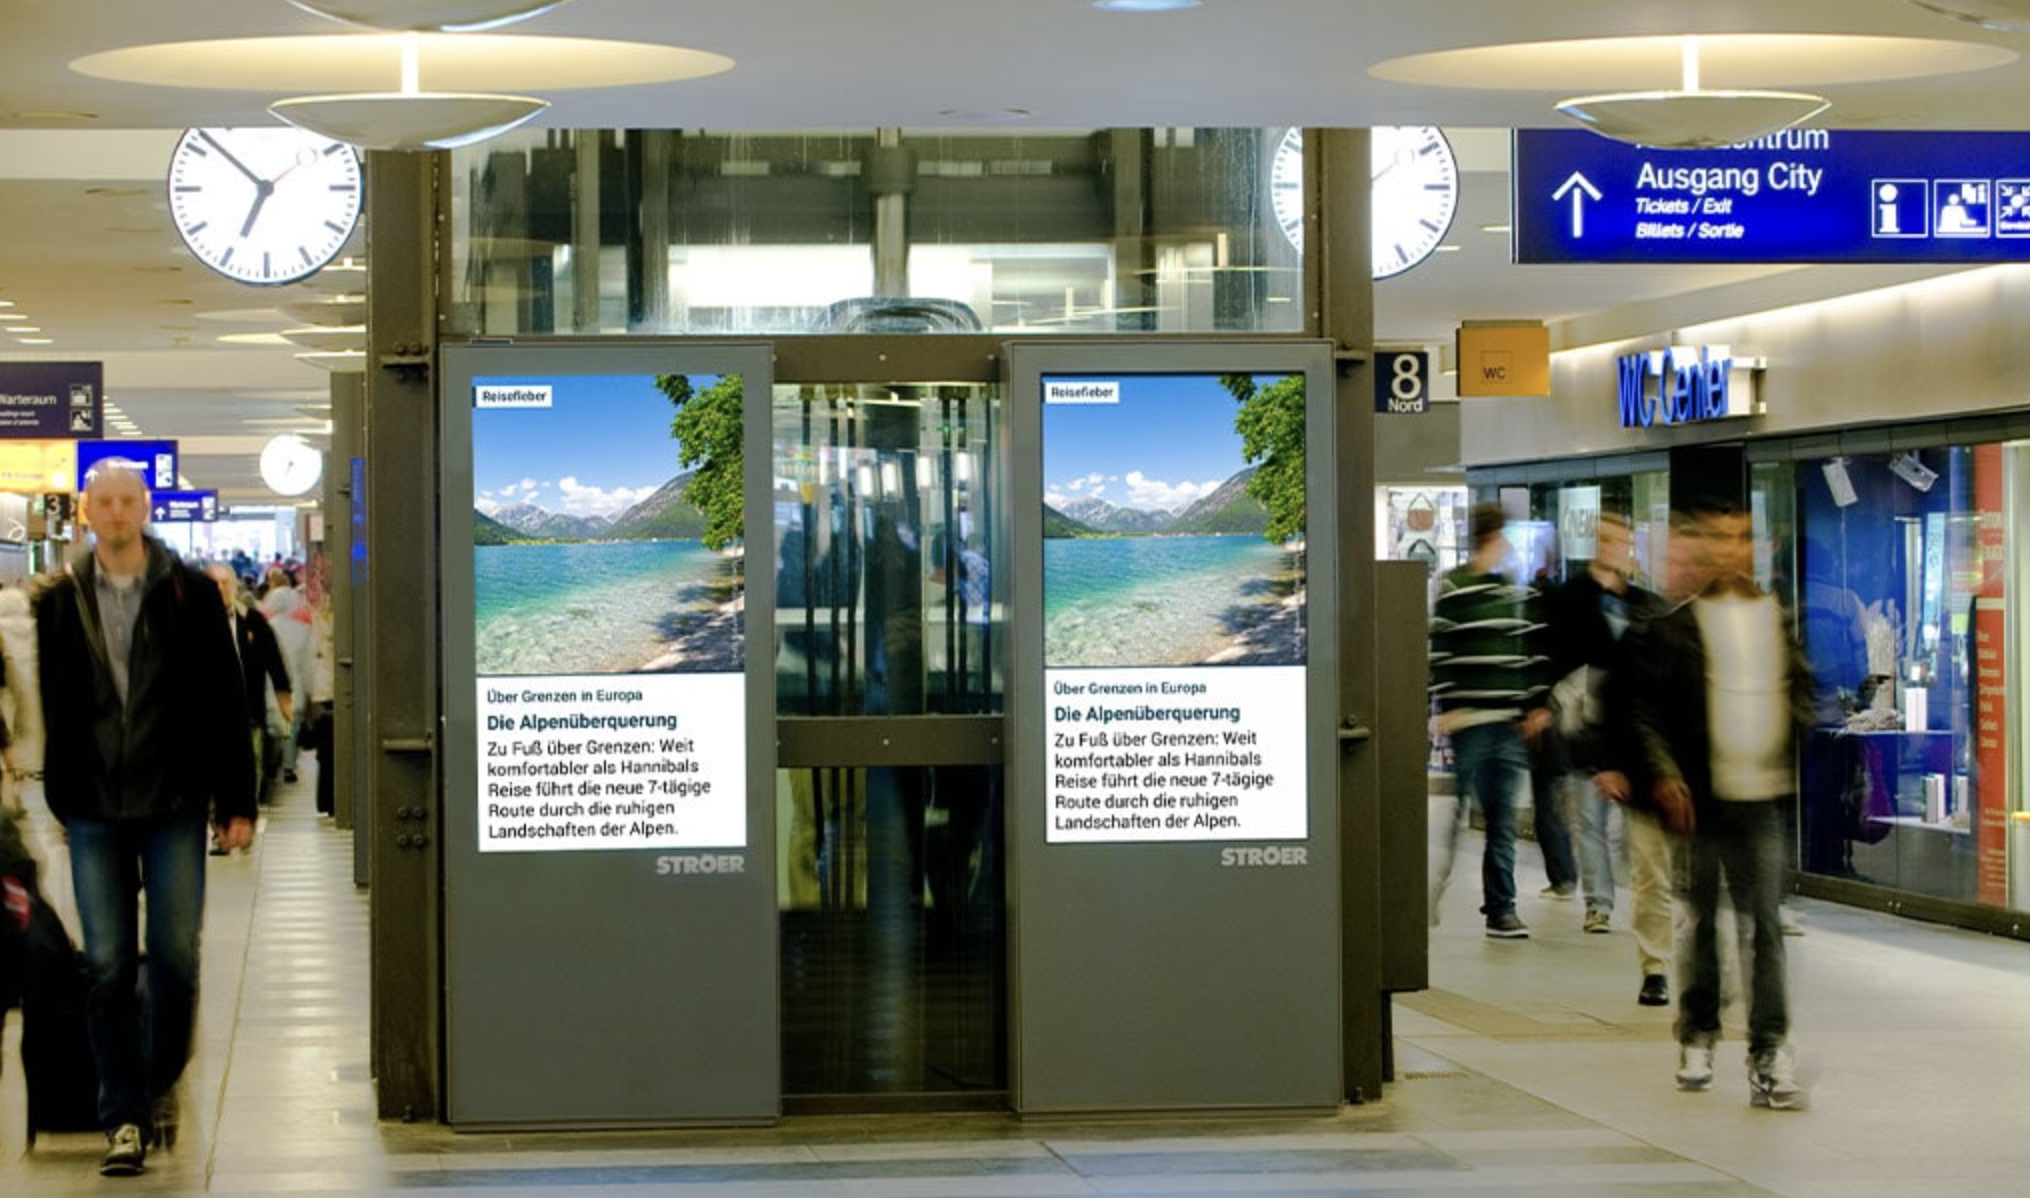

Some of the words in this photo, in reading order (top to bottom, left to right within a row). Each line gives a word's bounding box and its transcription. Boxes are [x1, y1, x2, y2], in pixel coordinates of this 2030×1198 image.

[1636, 162, 1759, 196] Ausgang
[1768, 162, 1823, 196] City
[1635, 198, 1689, 214] Tickets
[1703, 198, 1733, 214] Exit
[1698, 222, 1745, 238] Sortie
[1391, 354, 1421, 399] 8
[1483, 367, 1506, 379] WC
[1052, 386, 1113, 397] Reisefieber
[1617, 351, 1657, 428] WC
[1660, 344, 1733, 425] Center
[482, 390, 546, 402] Reisefieber
[1387, 398, 1423, 412] Nord
[487, 689, 518, 704] Über
[522, 690, 576, 702] Grenzen
[580, 690, 593, 702] in
[596, 690, 642, 703] Europa
[1054, 681, 1085, 695] Über
[1088, 682, 1142, 694] Grenzen
[1146, 683, 1158, 693] in
[1161, 682, 1206, 696] Europa
[488, 714, 515, 730] Die
[520, 713, 677, 732] Alpenüberquerung
[1055, 706, 1082, 722] Die
[1086, 705, 1240, 724] Alpenüberquerung
[488, 742, 507, 756] Zu
[513, 740, 543, 756] Fuß
[547, 740, 582, 756] über
[586, 740, 654, 754] Grenzen:
[659, 739, 693, 753] Weit
[1055, 733, 1074, 748] Zu
[1079, 732, 1108, 747] Fuß
[1113, 732, 1147, 747] über
[1151, 732, 1218, 746] Grenzen:
[1223, 730, 1256, 745] Weit
[488, 761, 588, 776] komfortabler
[593, 760, 616, 774] als
[621, 758, 699, 774] Hannibals
[1055, 753, 1154, 768] komfortabler
[1158, 752, 1180, 767] als
[1185, 751, 1262, 766] Hannibals
[489, 782, 532, 797] Reise
[536, 782, 573, 796] führt
[578, 781, 601, 796] die
[606, 784, 644, 795] neue
[648, 779, 711, 797] 7-tägige
[1055, 774, 1097, 788] Reise
[1102, 773, 1138, 788] führt
[1143, 772, 1166, 788] die
[1170, 776, 1207, 787] neue
[1212, 771, 1274, 790] 7-tägige
[489, 804, 534, 818] Route
[540, 802, 584, 816] durch
[588, 802, 612, 816] die
[616, 801, 674, 818] ruhigen
[1056, 795, 1101, 809] Route
[1105, 794, 1149, 808] durch
[1153, 792, 1176, 808] die
[1180, 792, 1238, 810] ruhigen
[489, 823, 596, 838] Landschaften
[600, 822, 626, 836] der
[630, 821, 677, 838] Alpen.
[1056, 814, 1160, 830] Landschaften
[1165, 814, 1189, 828] der
[1194, 813, 1240, 830] Alpen.
[656, 854, 745, 875] STRÖER
[1221, 846, 1309, 867] STRÖER
